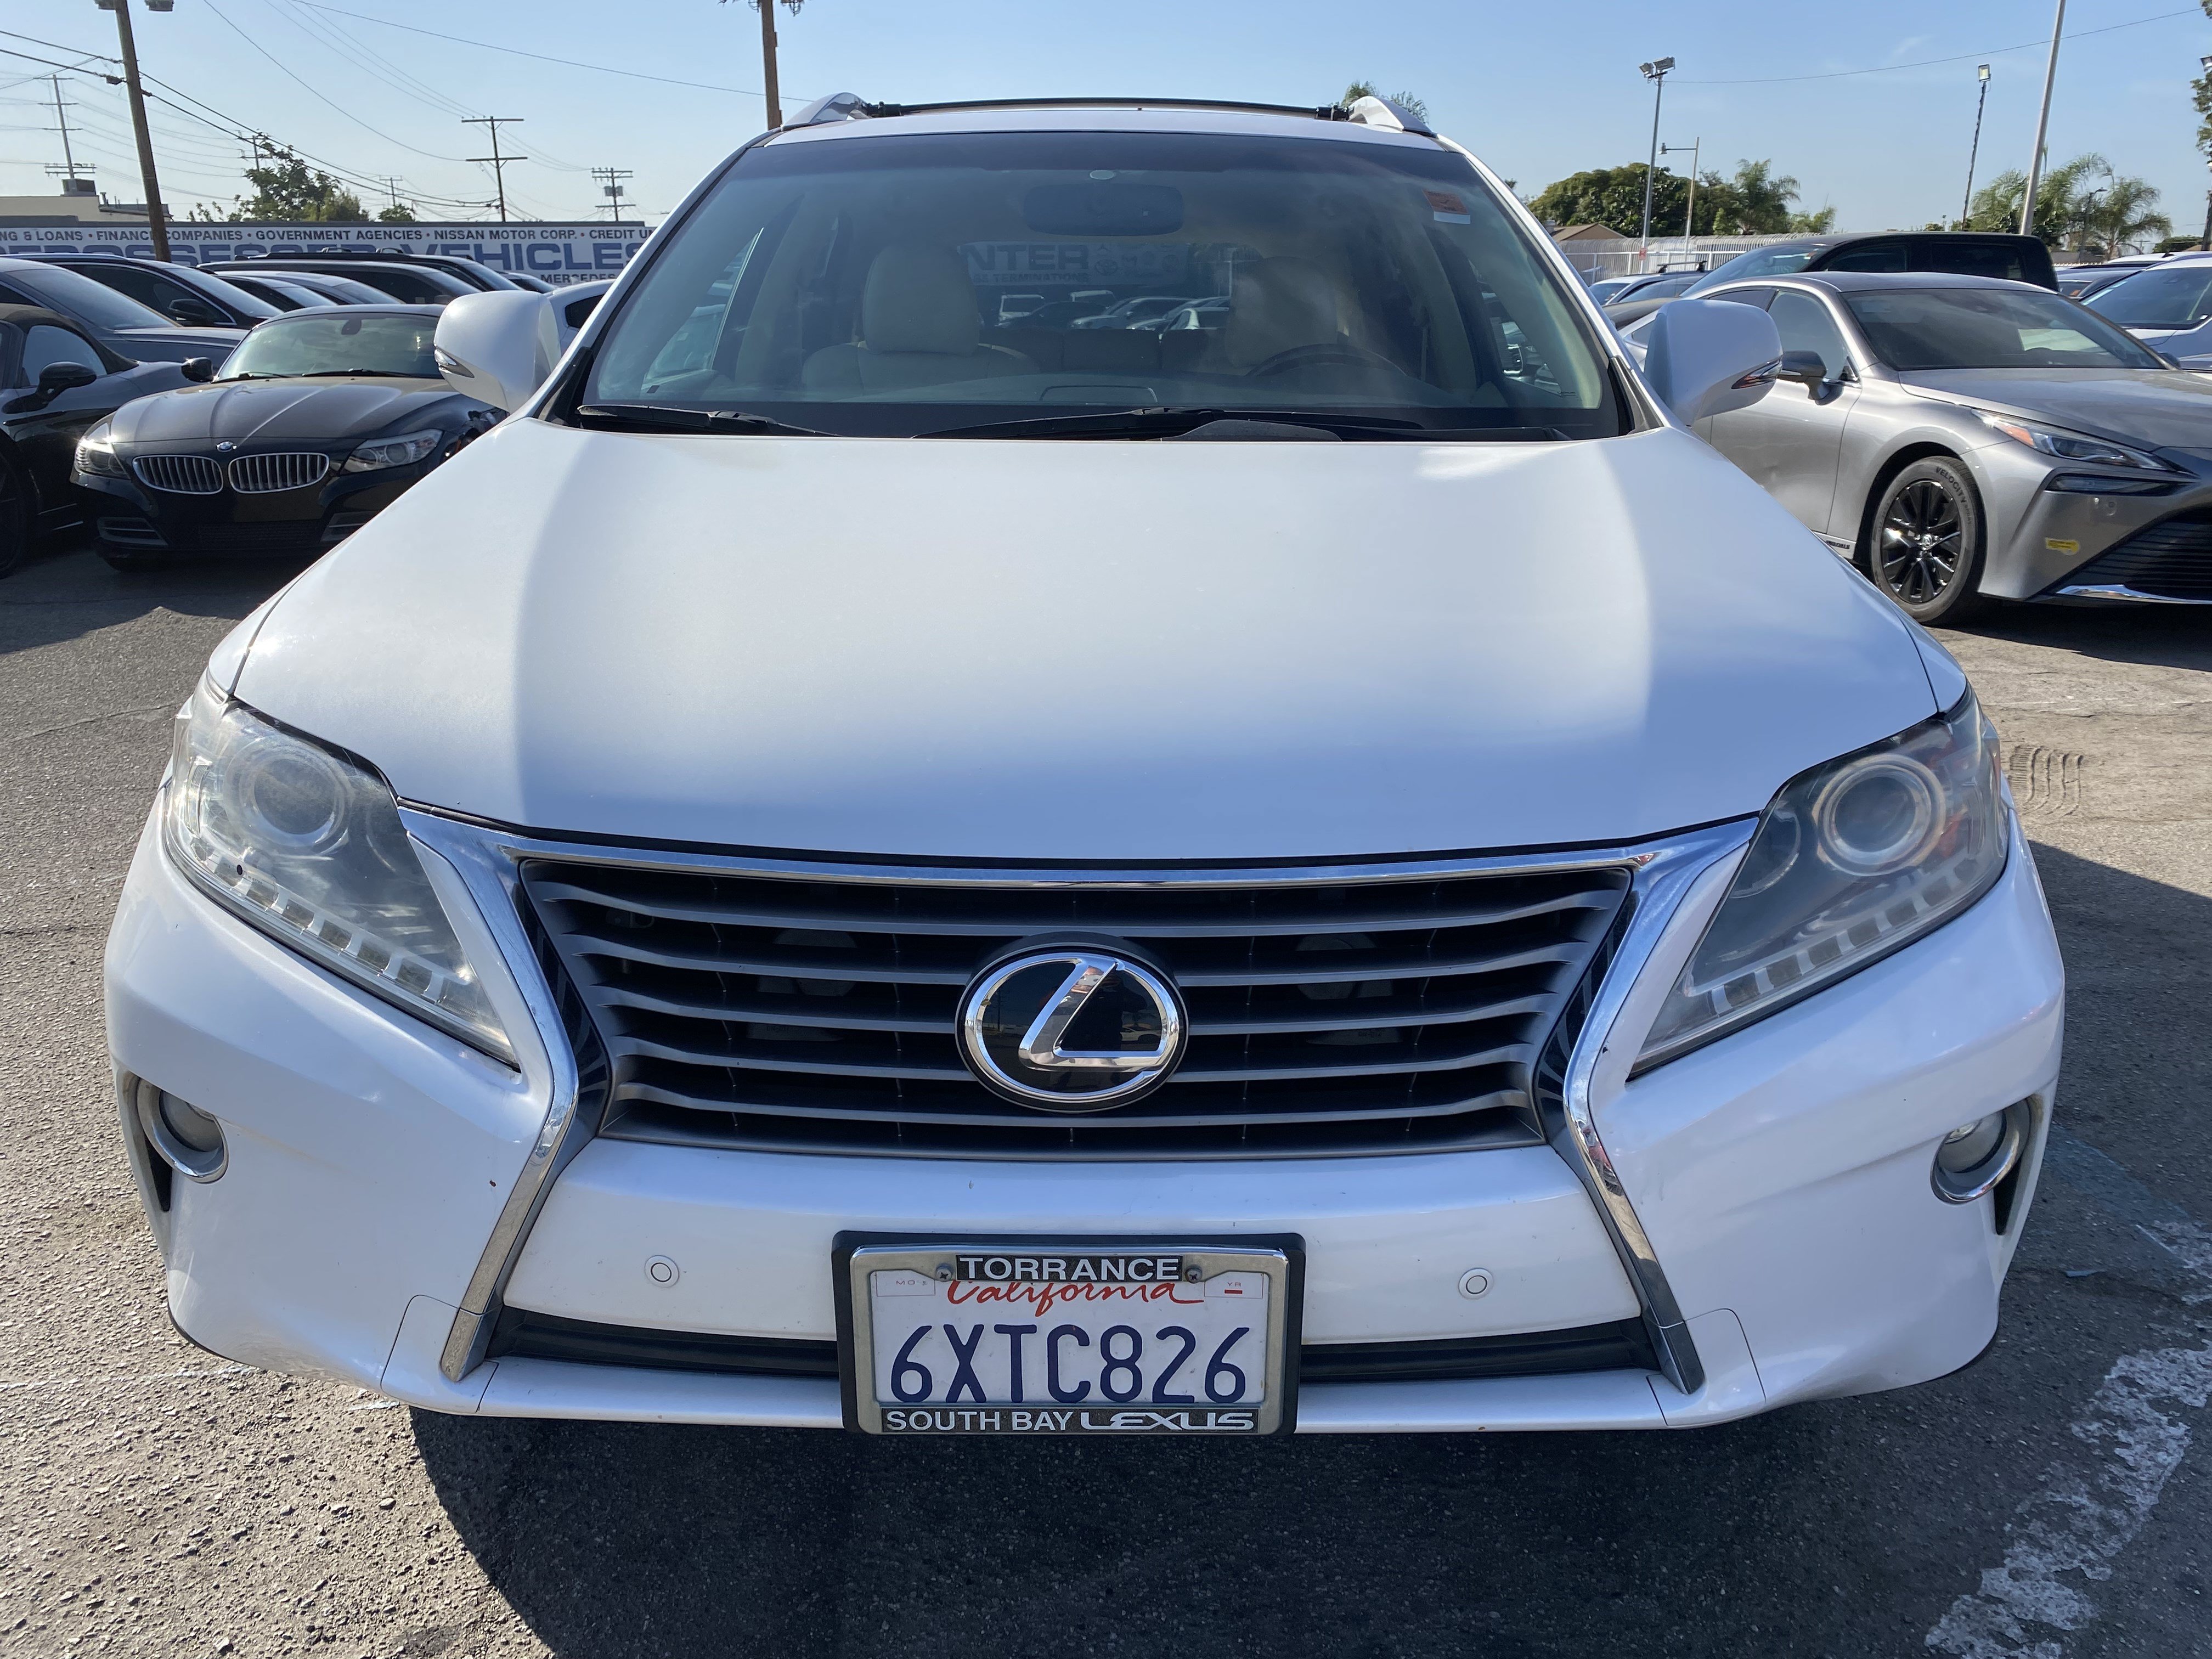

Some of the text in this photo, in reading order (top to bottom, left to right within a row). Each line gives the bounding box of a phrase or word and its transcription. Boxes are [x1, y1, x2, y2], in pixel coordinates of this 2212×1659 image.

[23, 231, 32, 241] &
[36, 230, 83, 241] LOANS
[256, 230, 351, 240] GOVERNMENT
[357, 230, 422, 240] AGENCIES
[434, 230, 484, 240] NISSAN
[490, 230, 535, 240] MOTOR
[540, 229, 577, 239] CORP.
[589, 229, 635, 239] CREDIT
[960, 1257, 1180, 1281] TORRANCE
[947, 1280, 1205, 1317] California
[890, 1324, 1250, 1403] 6XTC826
[886, 1411, 1254, 1431] SOUTH BAY LEXUS
